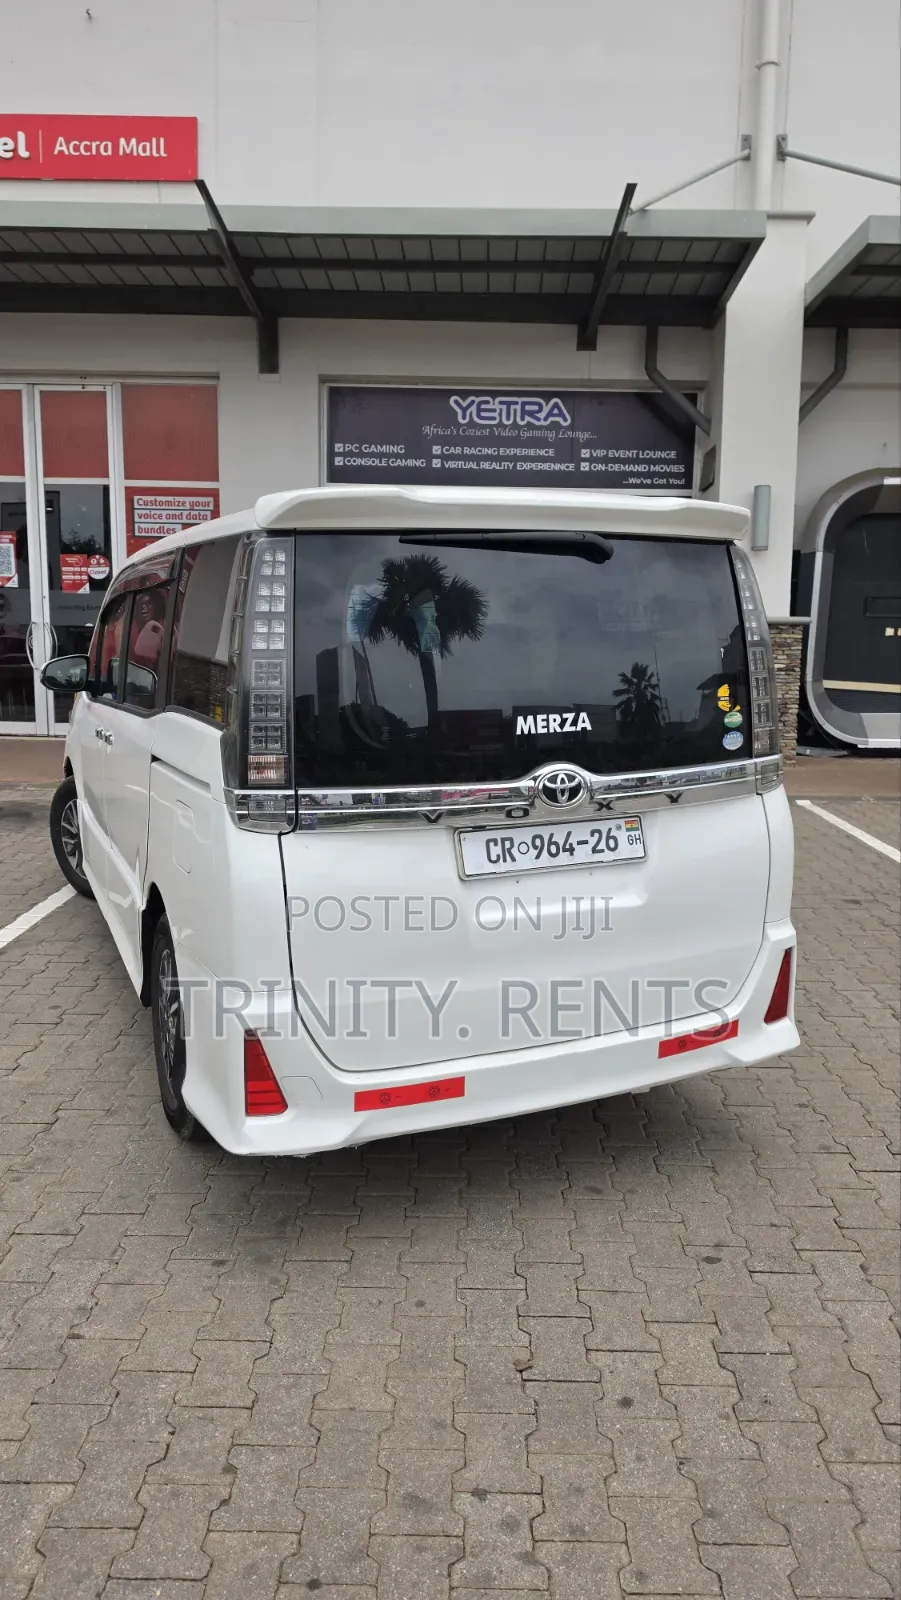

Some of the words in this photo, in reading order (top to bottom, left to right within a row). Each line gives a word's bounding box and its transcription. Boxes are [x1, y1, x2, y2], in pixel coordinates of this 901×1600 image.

[54, 136, 112, 156] Accra
[119, 137, 168, 157] Mall
[450, 396, 571, 426] YETRA
[422, 424, 457, 439] Africa's
[459, 426, 490, 436] Coziest
[492, 426, 518, 437] Video
[520, 428, 556, 441] Gaming
[558, 429, 597, 442] Lounge...
[345, 443, 359, 452] PC
[362, 444, 405, 453] GAMING
[443, 446, 462, 455] CAR
[463, 447, 498, 456] RACING
[500, 448, 555, 457] EXPERIENCE
[591, 450, 607, 458] VIP
[608, 450, 638, 458] EVENT
[639, 450, 676, 459] LOUNGE
[345, 457, 387, 466] CONSOLE
[389, 458, 426, 467] GAMING
[443, 460, 479, 469] VIRTUAL
[480, 461, 514, 470] REALITY
[591, 463, 648, 472] ON-DEMAND
[650, 464, 685, 473] MOVIES
[653, 477, 667, 485] Got
[668, 477, 685, 485] You!
[136, 497, 187, 508] Customize
[188, 499, 211, 510] your
[137, 510, 163, 520] voice
[165, 511, 184, 520] and
[185, 512, 208, 521] data
[137, 525, 177, 535] bundles
[516, 711, 592, 736] MERZA
[485, 837, 517, 864] CR
[531, 827, 619, 860] 964-26
[627, 833, 643, 847] GH
